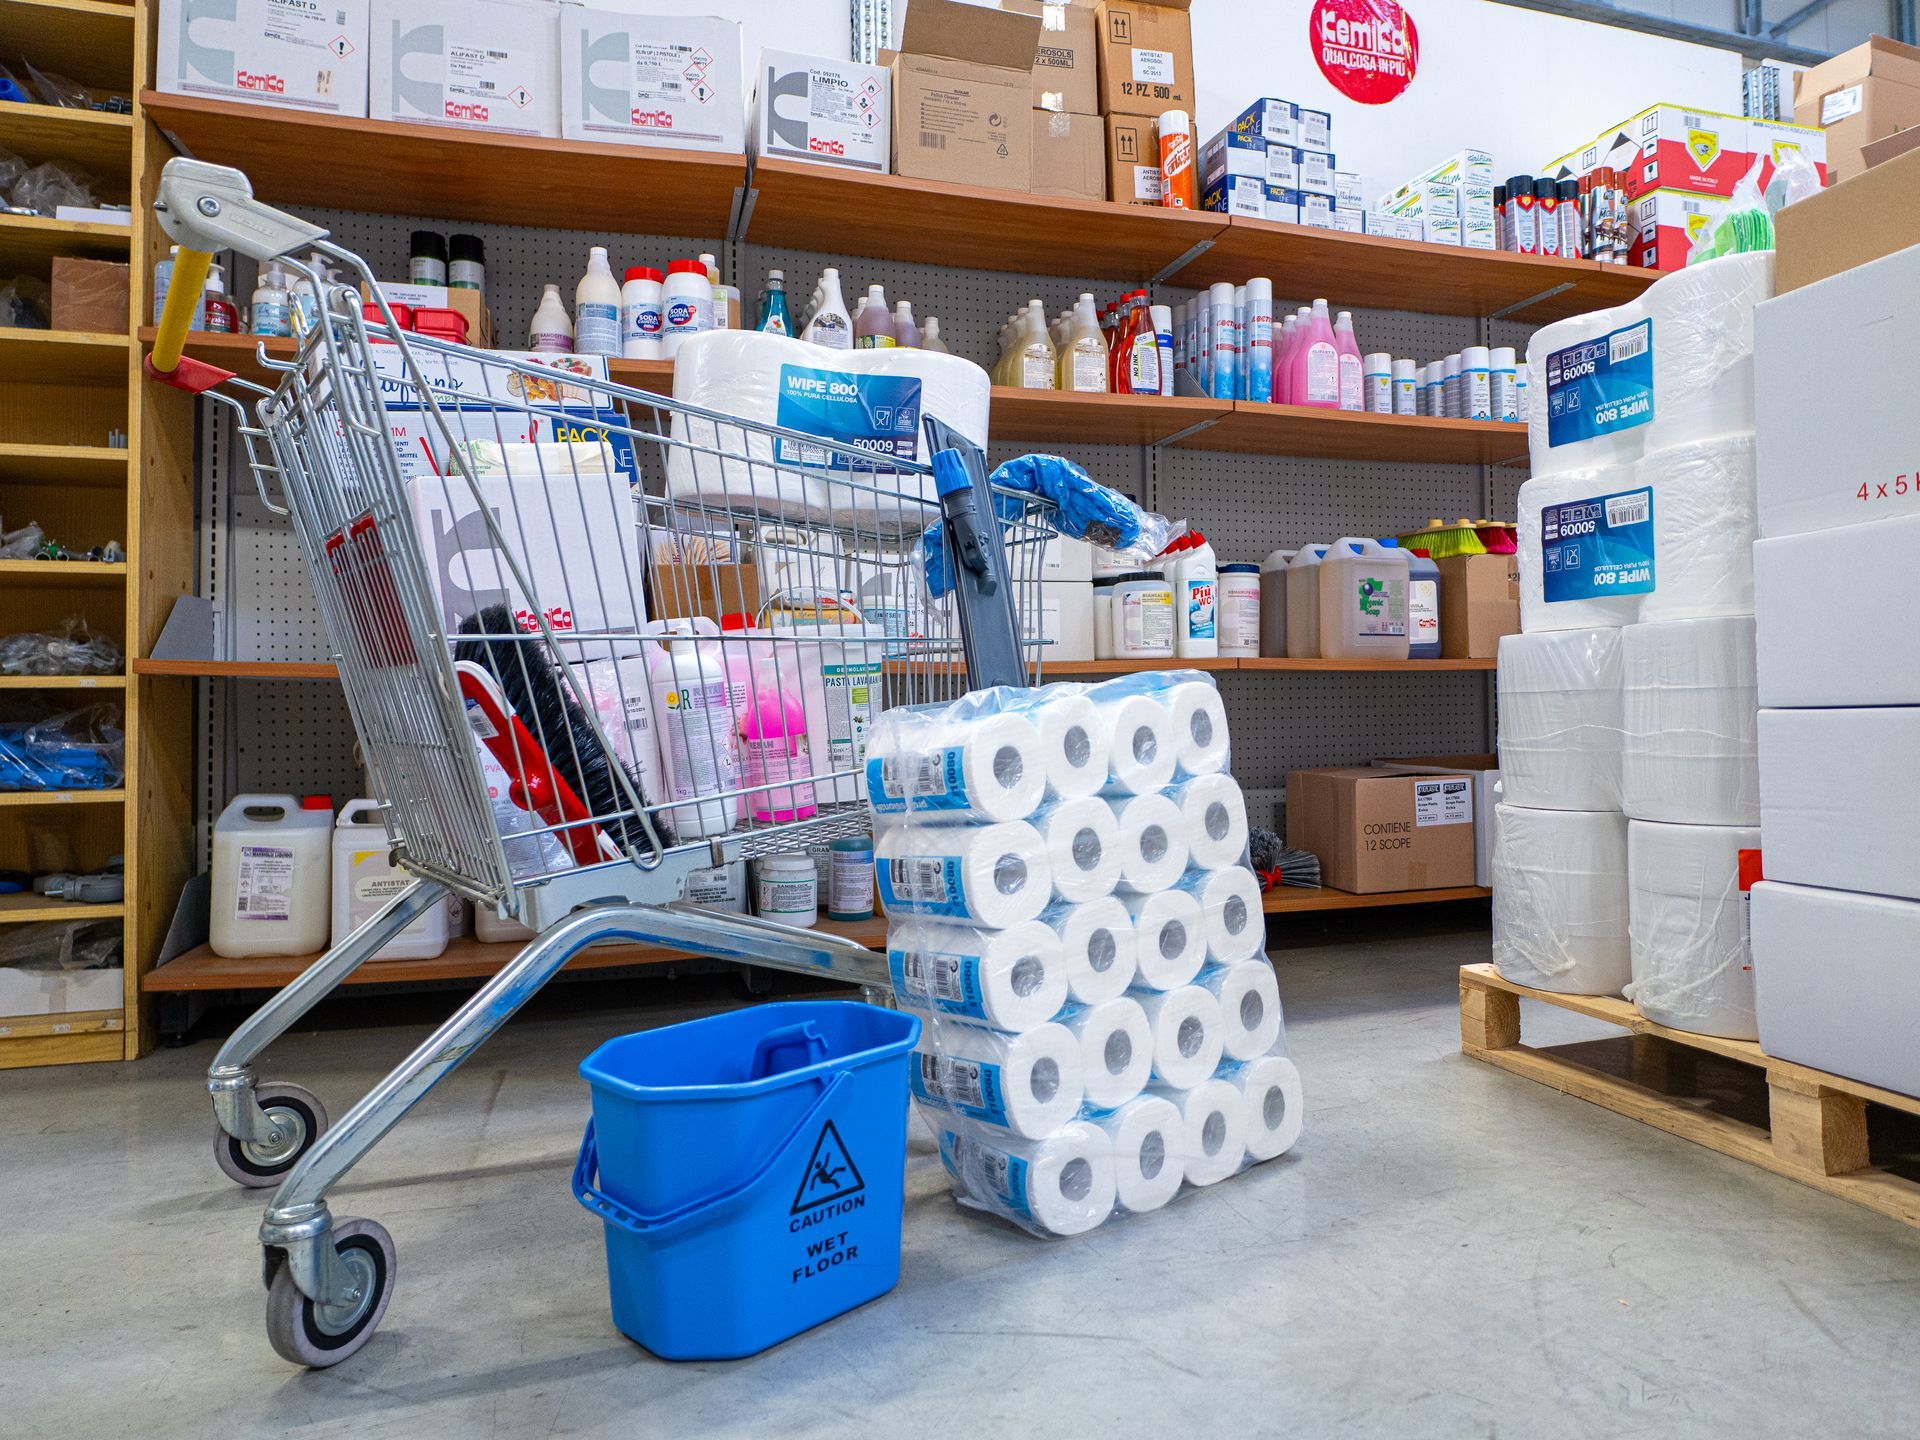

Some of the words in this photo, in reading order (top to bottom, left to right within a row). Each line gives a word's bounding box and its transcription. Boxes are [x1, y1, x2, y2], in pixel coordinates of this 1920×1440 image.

[1323, 47, 1376, 71] QUALCOSA
[1378, 58, 1388, 73] IN
[812, 76, 848, 87] LIMPIO
[1121, 82, 1132, 94] 12
[1136, 83, 1150, 97] PZ.
[1154, 86, 1169, 100] 500
[1238, 111, 1256, 133] PACK
[1205, 188, 1222, 209] PACK
[1270, 188, 1285, 196] PACK
[1134, 367, 1138, 377] NO
[1564, 361, 1595, 380] 50009
[787, 375, 826, 393] WIPE
[830, 383, 858, 396] 800
[822, 394, 857, 403] CELLULOSA
[1620, 398, 1649, 418] WIPE
[1596, 409, 1618, 424] 800
[853, 439, 893, 452] 50009
[1857, 482, 1869, 500] 4
[1876, 482, 1888, 499] x
[1895, 474, 1907, 495] 5
[1560, 521, 1596, 536] 50009
[1594, 572, 1615, 586] 800
[1619, 568, 1650, 584] WIPE
[1198, 597, 1212, 607] WC
[1365, 609, 1380, 617] Soap
[1364, 822, 1411, 835] CONTIENE
[1366, 841, 1376, 851] 12
[1380, 838, 1411, 850] SCOPE
[790, 1194, 865, 1233] CAUTION
[806, 1231, 848, 1258] WET
[792, 1246, 858, 1283] FLOOR
